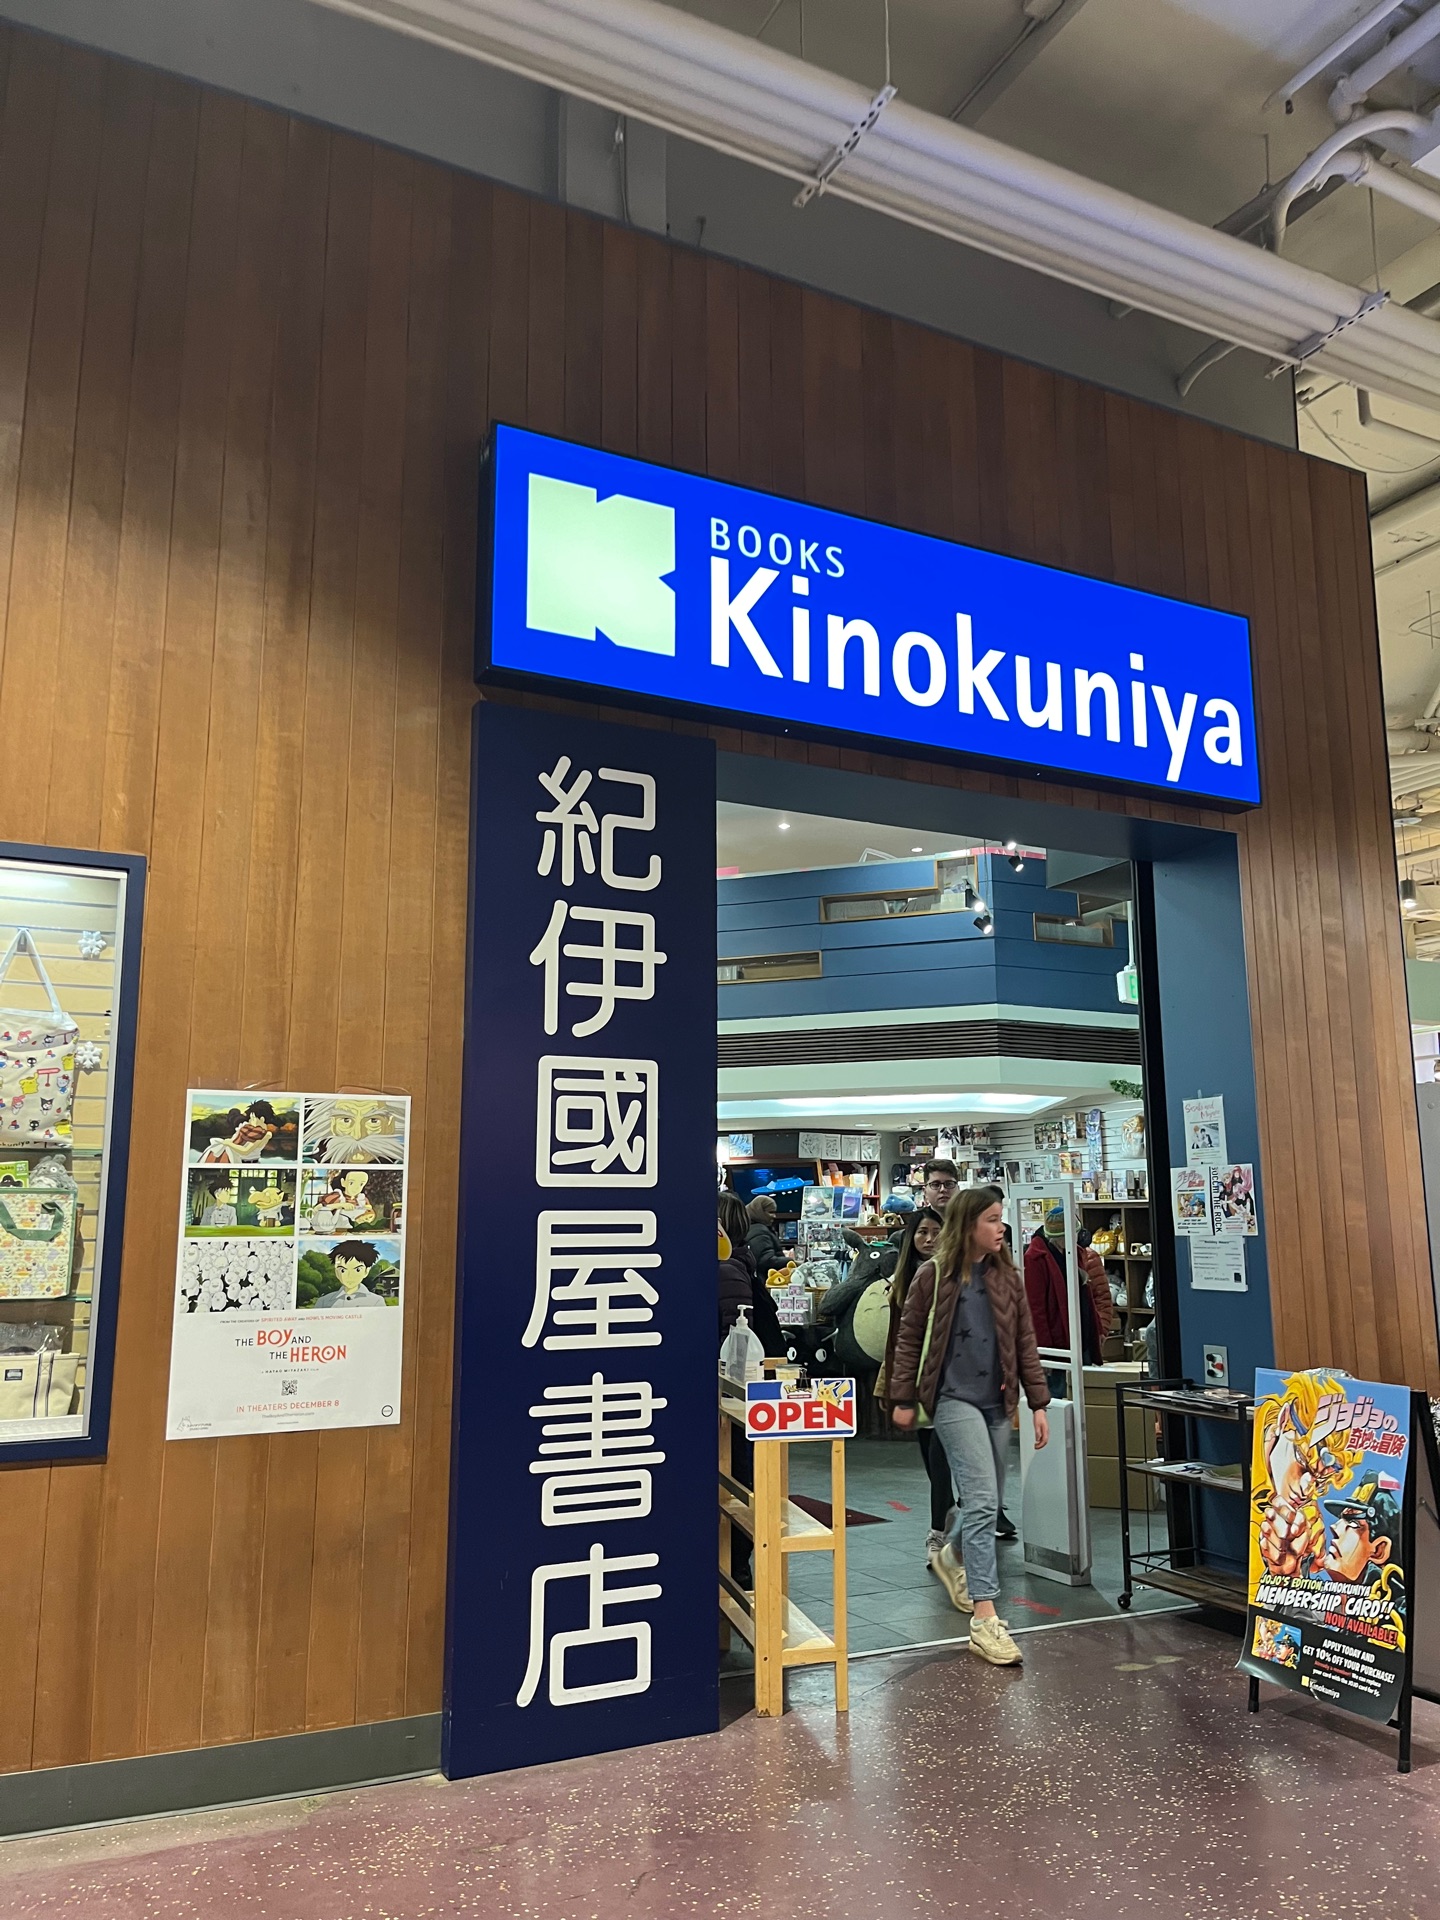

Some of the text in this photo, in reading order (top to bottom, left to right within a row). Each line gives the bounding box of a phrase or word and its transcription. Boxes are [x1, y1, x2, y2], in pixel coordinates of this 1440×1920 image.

[711, 517, 845, 578] BOOKS
[711, 555, 1243, 782] Kinokuniya
[1212, 1195, 1221, 1210] THE
[516, 755, 667, 1707] 紀伊國屋書店
[1214, 1211, 1223, 1233] ROCK
[235, 1329, 312, 1348] THE BOY AND
[269, 1345, 347, 1363] THE HERON
[247, 1403, 288, 1413] THEATERS
[290, 1400, 332, 1410] DECEMBER
[748, 1399, 854, 1431] OPEN
[1308, 1393, 1399, 1449] ジョジョの
[1260, 1575, 1372, 1597] JOJO'S EDITION KINOKUNIYA
[1255, 1585, 1395, 1620] MEMBERSHIP CARD!!
[1324, 1612, 1398, 1645] NOW AVAILABLE!
[1302, 1645, 1316, 1656] GET
[1315, 1648, 1332, 1662] 10%
[1331, 1654, 1344, 1666] OFF
[1343, 1658, 1361, 1672] YOUR
[1360, 1664, 1396, 1684] PURCHASE!
[1322, 1639, 1376, 1664] APPLY TODAY AND
[1309, 1680, 1341, 1699] Kinokuniya
